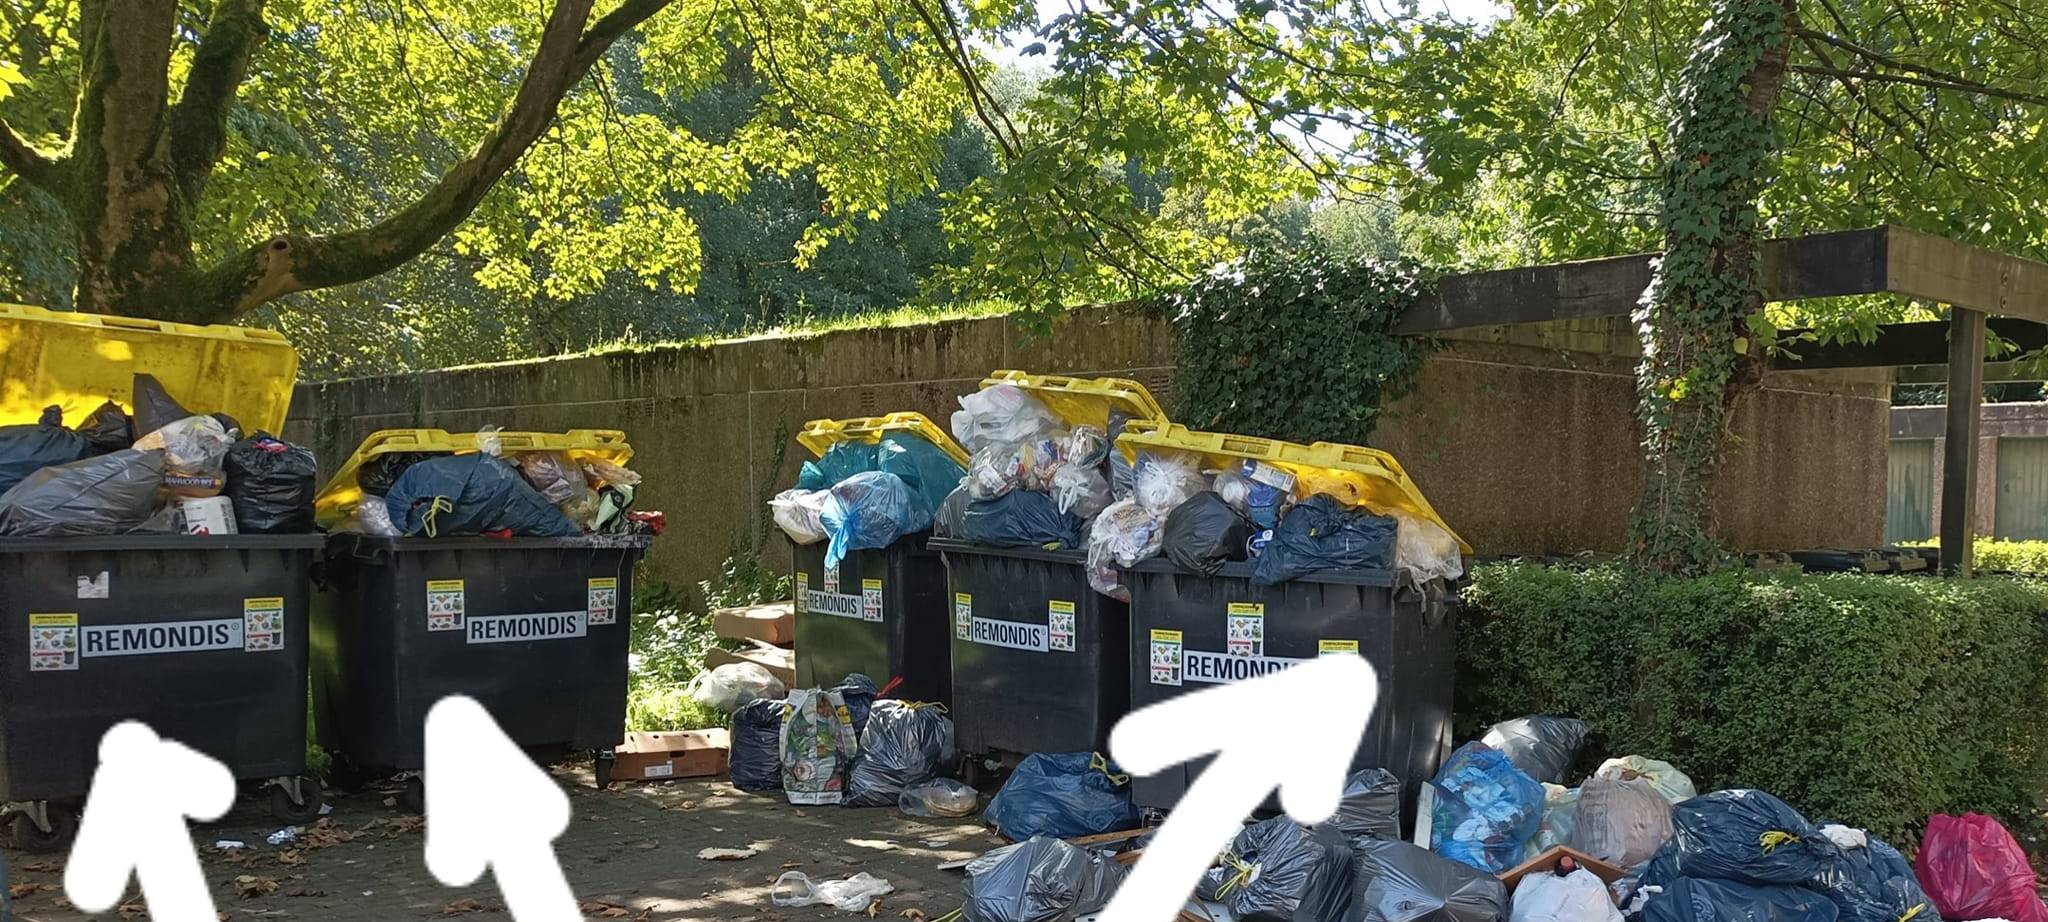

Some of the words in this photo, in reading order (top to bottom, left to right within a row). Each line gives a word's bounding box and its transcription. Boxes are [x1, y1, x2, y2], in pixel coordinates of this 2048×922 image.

[809, 592, 857, 614] REMONDIS
[87, 624, 229, 652] REMONDIS
[471, 615, 576, 640] REMONDIS
[975, 622, 1041, 647] REMONDIS
